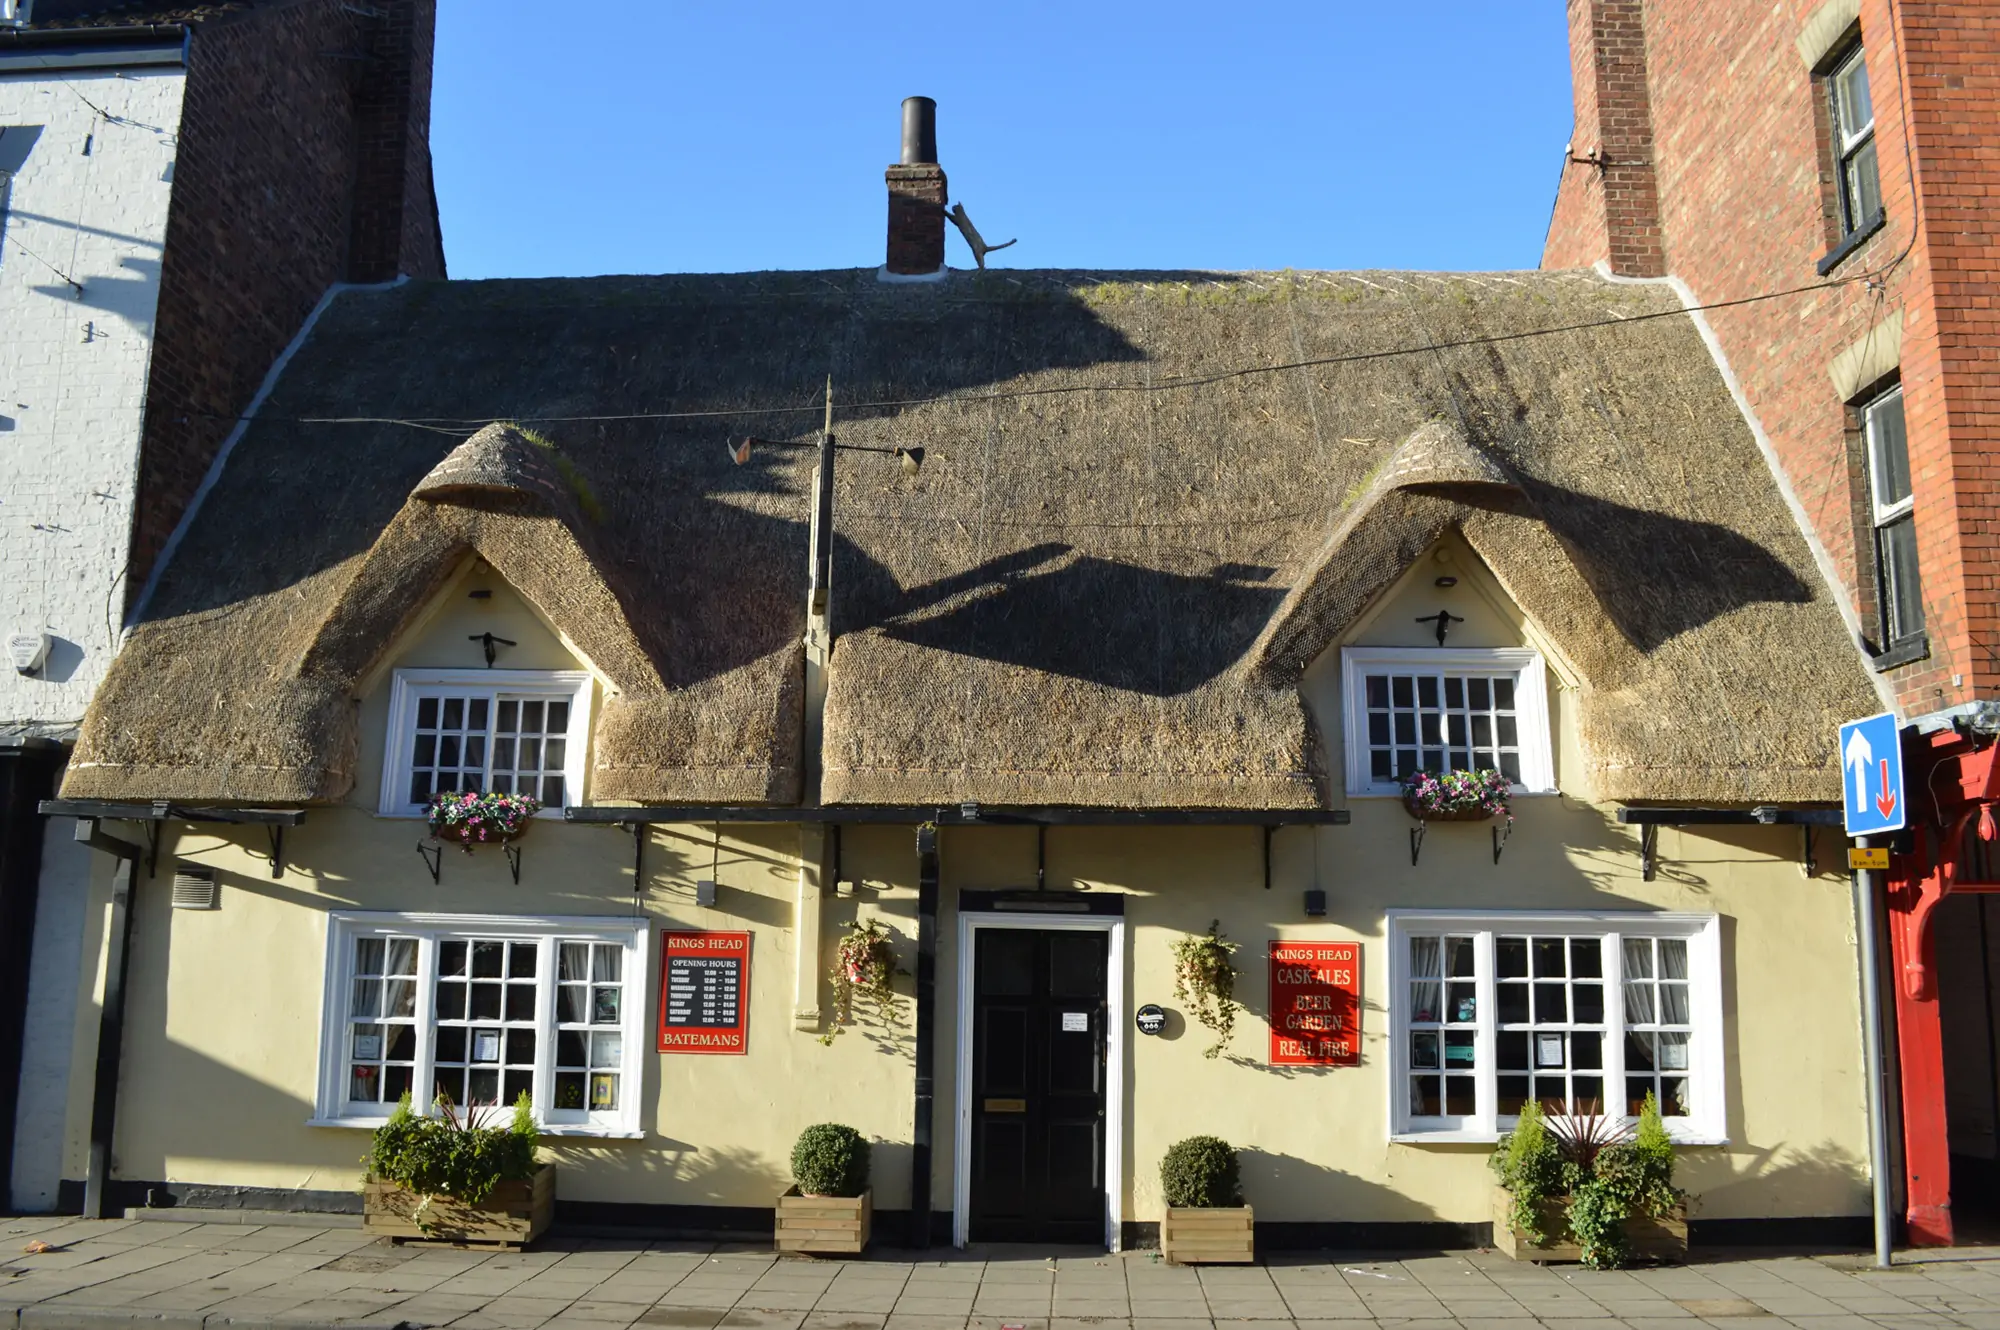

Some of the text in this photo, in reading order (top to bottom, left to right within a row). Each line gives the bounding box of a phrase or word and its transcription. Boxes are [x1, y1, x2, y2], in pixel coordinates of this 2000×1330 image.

[668, 938, 743, 949] KINGS HEAD
[1276, 950, 1352, 960] KINGS HEAD
[709, 960, 736, 968] HOURS
[1277, 968, 1351, 985] CASK ALES
[1296, 995, 1332, 1011] BEER
[1286, 1014, 1342, 1030] GARDEN
[664, 1034, 740, 1046] BATEMANS
[1280, 1040, 1350, 1057] REAL FIRE
